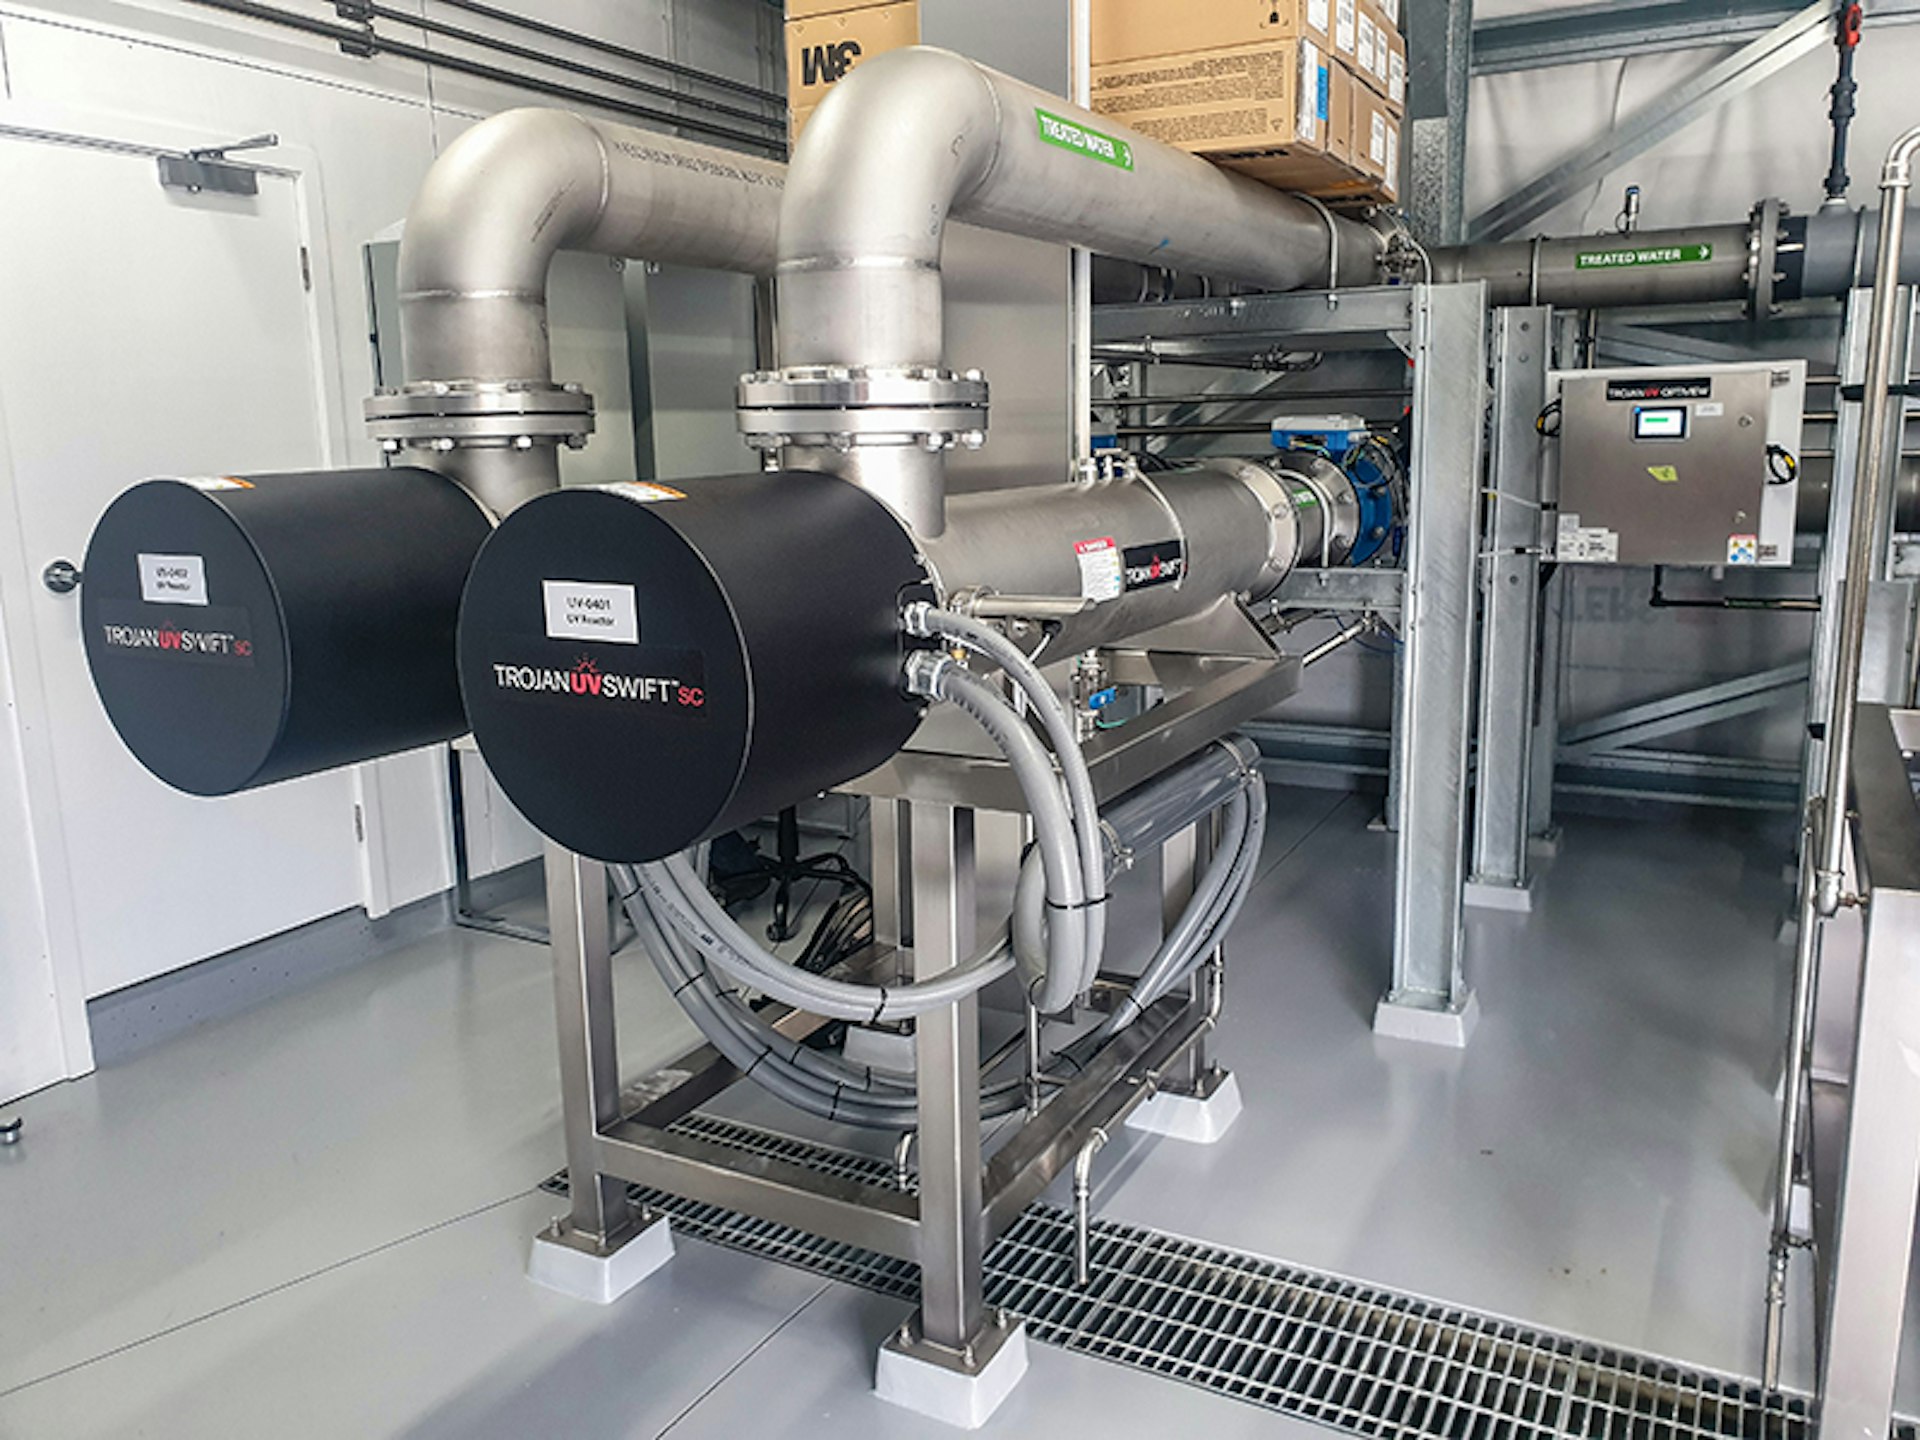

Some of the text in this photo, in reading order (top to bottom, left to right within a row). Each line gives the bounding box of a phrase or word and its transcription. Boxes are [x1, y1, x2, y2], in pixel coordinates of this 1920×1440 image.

[802, 41, 861, 85] 3M
[1040, 114, 1116, 160] TREATED WATER
[1580, 248, 1681, 266] TREATED WATER
[677, 685, 705, 708] SC
